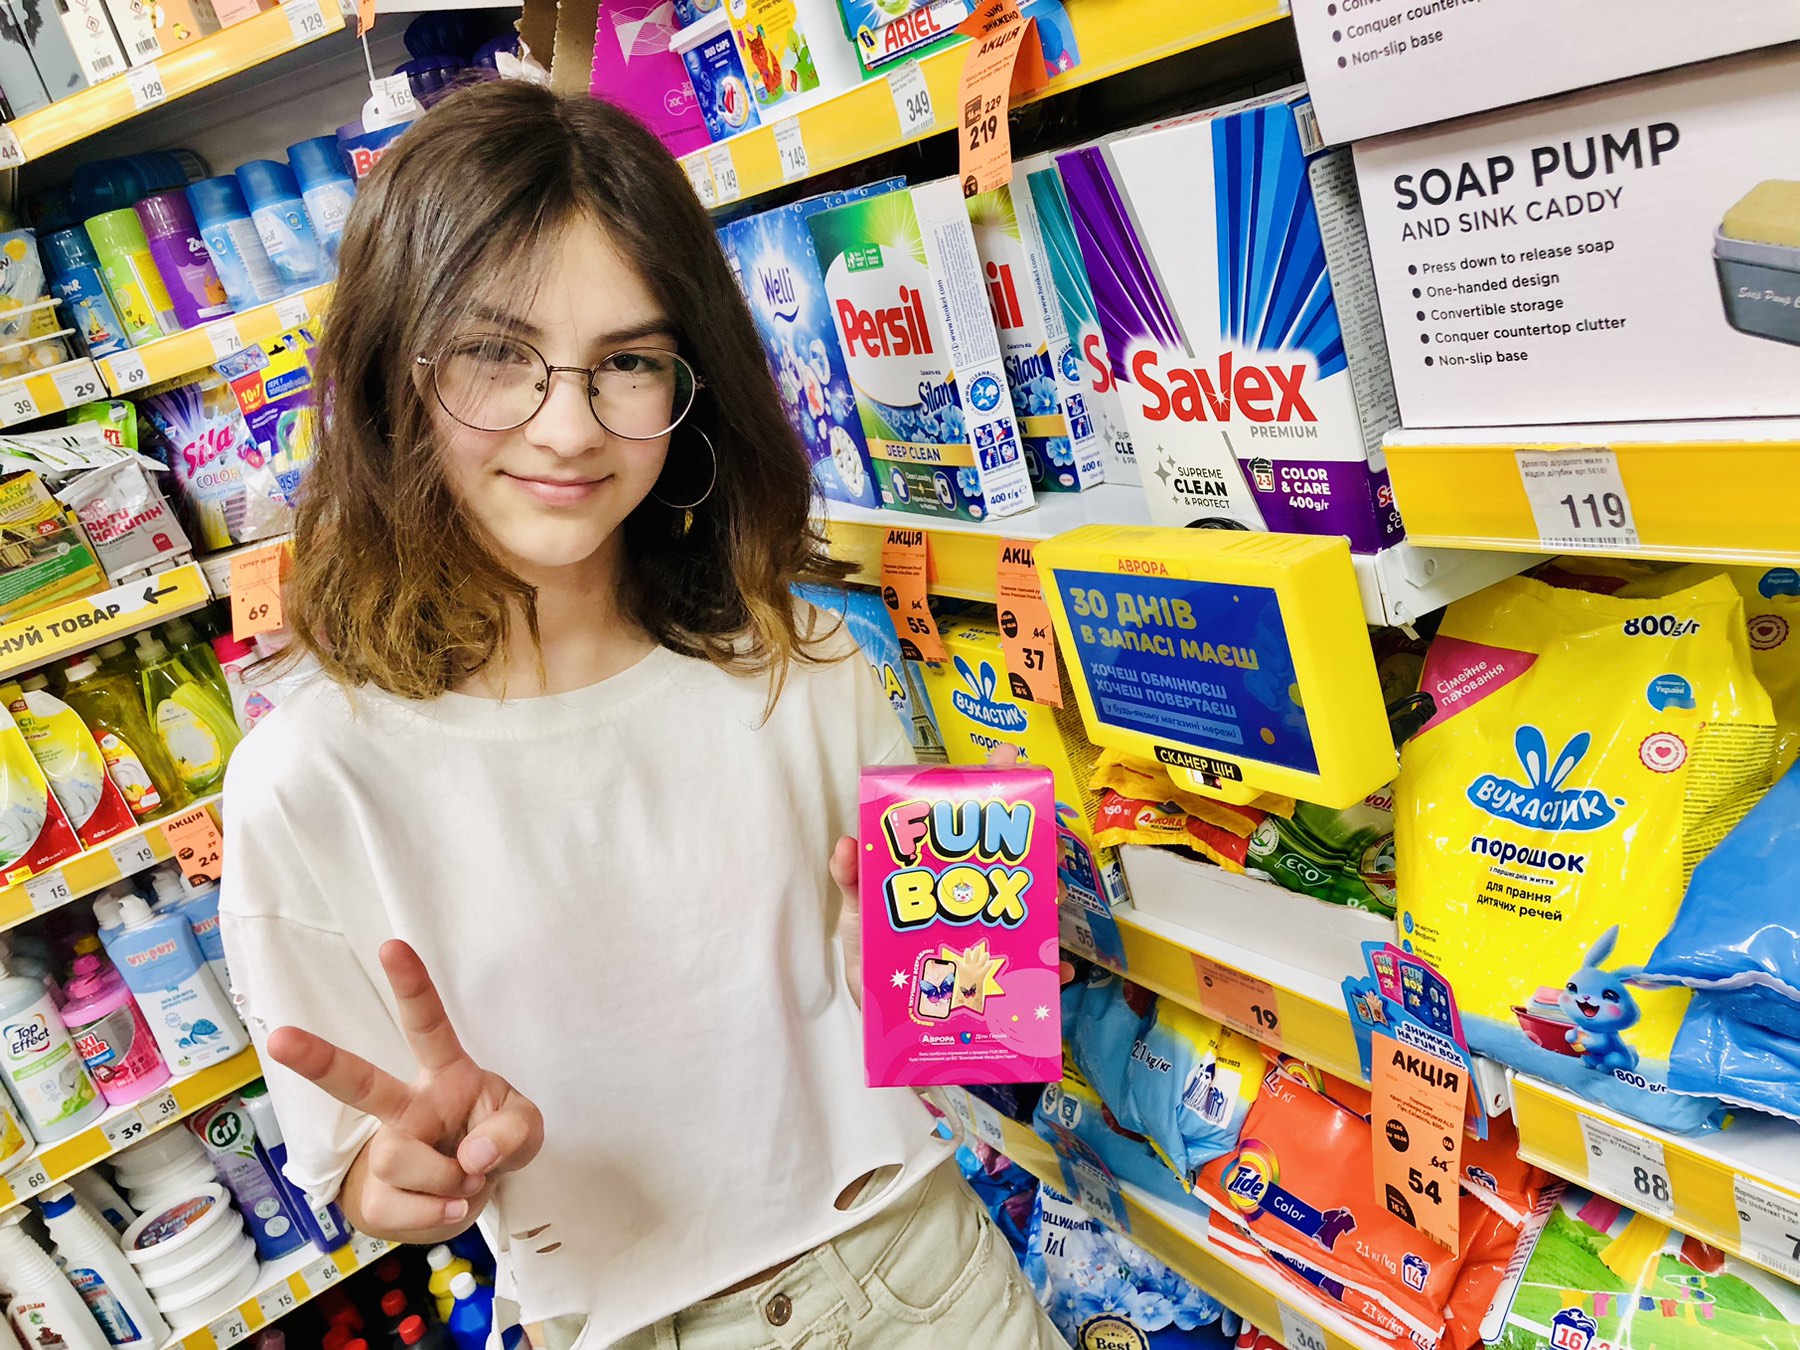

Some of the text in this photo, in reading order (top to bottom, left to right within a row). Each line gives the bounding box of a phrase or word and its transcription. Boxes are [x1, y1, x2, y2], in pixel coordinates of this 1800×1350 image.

[301, 13, 323, 33] 129
[886, 8, 941, 52] ARIEL
[982, 10, 1018, 32] ЗНИЖЕНО
[1347, 13, 1402, 39] Conquer
[977, 26, 1021, 58] АКЦІЯ
[1352, 30, 1443, 66] Non-slip base
[141, 82, 163, 100] 129
[391, 89, 412, 107] 169
[906, 90, 930, 121] 349
[985, 95, 1001, 114] 229
[970, 115, 997, 150] 219
[788, 146, 806, 169] 149
[1394, 122, 1680, 210] SOAP PUMP
[721, 169, 737, 190] 149
[1402, 187, 1623, 241] AND SINK CADDY
[1422, 238, 1615, 275] Press down to release soap
[758, 267, 796, 306] Welli
[1427, 272, 1560, 298] One-handed design
[1431, 298, 1564, 321] Convertible storage
[836, 285, 933, 358] Persil
[1435, 317, 1627, 345] Conquer countertop clutter
[227, 336, 240, 350] 74
[1439, 349, 1528, 367] Non-slip base
[129, 368, 144, 383] 69
[1004, 354, 1043, 390] Silan
[75, 383, 95, 397] 29
[1132, 350, 1317, 422] Savex
[14, 400, 31, 414] 39
[918, 381, 951, 416] Silan
[1250, 425, 1317, 438] PREMIUM
[183, 425, 235, 478] Sila
[886, 444, 941, 461] DEEP CLEAN
[197, 467, 240, 488] COLOR
[1177, 466, 1223, 480] SUPREME
[1257, 475, 1272, 487] 2-3
[1281, 467, 1328, 481] COLOR
[990, 492, 1006, 504] 400
[1174, 479, 1228, 496] CLEAN
[1281, 482, 1331, 495] & CARE
[1184, 497, 1230, 509] & PROTECT
[1560, 492, 1626, 528] 119
[887, 530, 922, 547] АКЦІЯ
[1117, 558, 1169, 577] АВРОРА
[249, 604, 268, 620] 69
[1069, 587, 1198, 630] 30 ДНІВ
[50, 604, 121, 638] ТОВАР
[906, 616, 931, 635] 55
[1023, 648, 1044, 670] 37
[1080, 624, 1259, 671] В ЗАПАСІ МАЄШ
[1090, 662, 1228, 700] ХОЧЕШ ОБМІНЮЄШ
[1437, 660, 1487, 694] Сімейне
[1441, 663, 1505, 706] паковання
[956, 695, 1023, 726] ВУХАСТИК
[1095, 679, 1237, 719] ХОЧЕШ ПОВЕРТАЄШ
[1161, 715, 1200, 732] магазині
[1201, 723, 1237, 740] мережі
[1159, 749, 1235, 781] СКАНЕР ЦІН
[1476, 779, 1604, 823] ВУХАСТИК
[168, 811, 204, 831] АКЦІЯ
[883, 800, 1034, 864] FUN
[137, 848, 152, 861] 19
[199, 852, 219, 867] 24
[1471, 837, 1584, 873] порошок
[51, 884, 67, 899] 15
[885, 865, 1031, 930] BOX
[1486, 881, 1551, 904] для прання
[1477, 894, 1562, 921] дитячих речей
[1076, 925, 1094, 948] 55
[1250, 1005, 1278, 1030] 19
[12, 1027, 50, 1055] Effect
[15, 1023, 38, 1040] Top
[1404, 1023, 1452, 1050] ЗНИЖКА
[1397, 1028, 1412, 1041] НА
[1414, 1036, 1436, 1052] FUN
[1440, 1048, 1462, 1063] BOX
[1393, 1050, 1458, 1093] АКЦІЯ
[1616, 1069, 1645, 1090] 800
[160, 1099, 176, 1114] 39
[121, 1122, 142, 1140] 39
[212, 1113, 238, 1145] Cif
[1430, 1155, 1448, 1172] 64
[28, 1173, 46, 1188] 69
[1228, 1166, 1264, 1196] Tide
[1408, 1167, 1442, 1205] 54
[1634, 1166, 1669, 1202] 88
[1274, 1196, 1305, 1222] Color
[1355, 1241, 1370, 1257] 2,1
[324, 1265, 338, 1280] 84
[1407, 1267, 1420, 1285] 14
[278, 1294, 292, 1308] 15
[229, 1322, 243, 1338] 27
[1558, 1328, 1583, 1350] 16
[1095, 1337, 1131, 1350] Best
